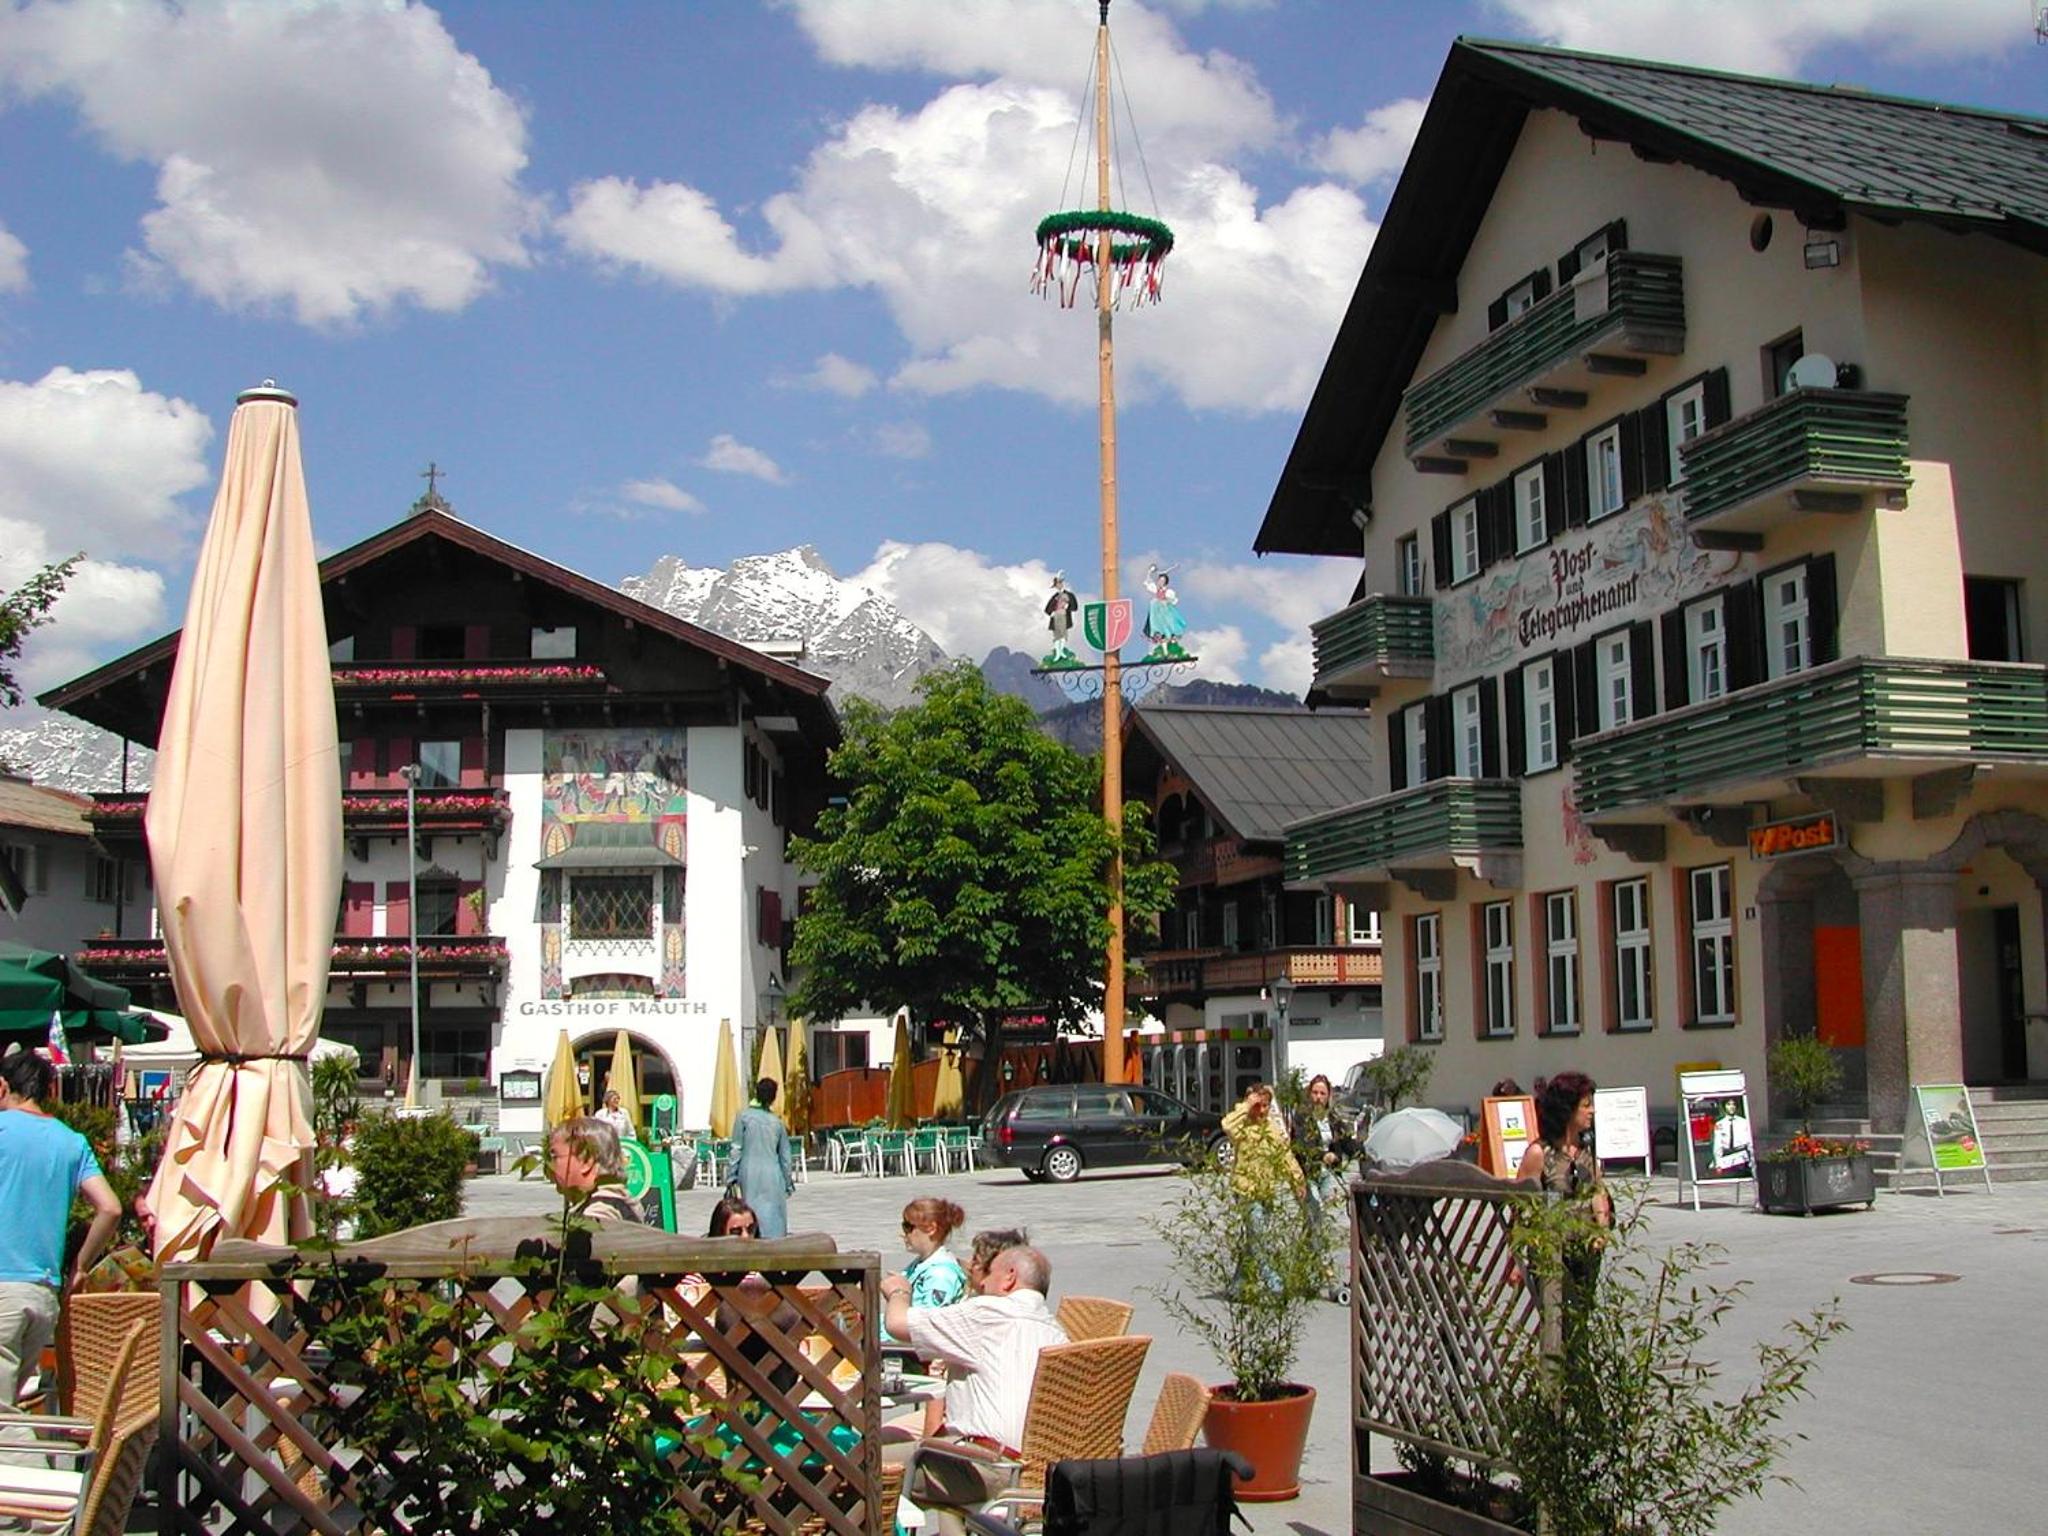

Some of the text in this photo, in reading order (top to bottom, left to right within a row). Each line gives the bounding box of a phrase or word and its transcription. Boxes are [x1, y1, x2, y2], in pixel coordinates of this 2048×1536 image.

[1565, 575, 1585, 596] und
[1518, 569, 1640, 649] Telegraphenamt
[1777, 816, 1833, 853] Post
[519, 1001, 707, 1016] GASTHOF MAUTH
